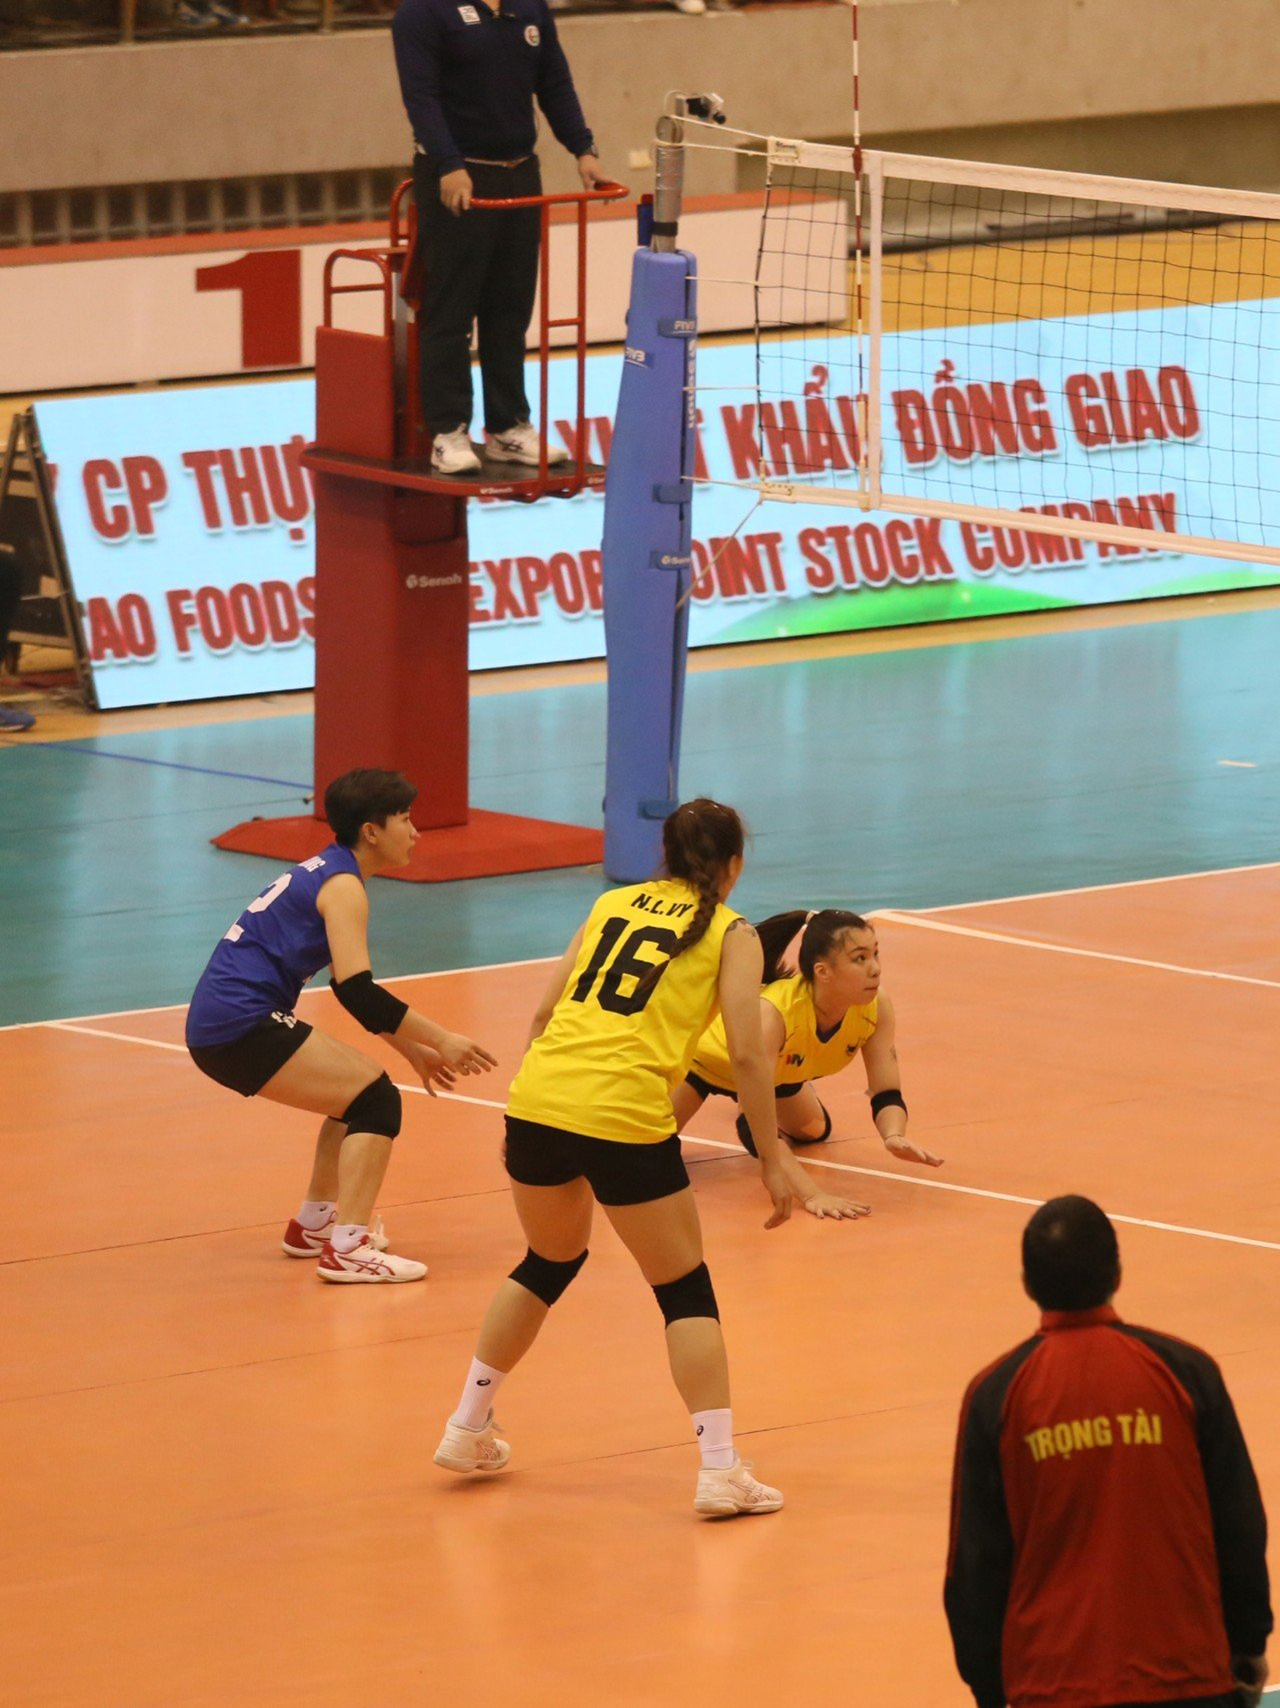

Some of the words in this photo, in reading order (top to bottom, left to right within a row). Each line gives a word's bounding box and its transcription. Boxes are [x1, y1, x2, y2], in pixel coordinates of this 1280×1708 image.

[196, 249, 301, 368] 1
[1065, 365, 1198, 447] GIAO
[82, 456, 168, 539] CP
[182, 434, 316, 541] THỰ
[469, 550, 602, 622] EXPOR
[690, 532, 786, 600] OINT
[798, 518, 954, 589] STOCK
[86, 593, 158, 661] AO
[166, 576, 316, 653] FOODS
[630, 892, 695, 918] N.L.VY
[571, 916, 682, 1017] 16
[1024, 1415, 1113, 1462] TRỌNG
[1117, 1407, 1163, 1445] TÀI
